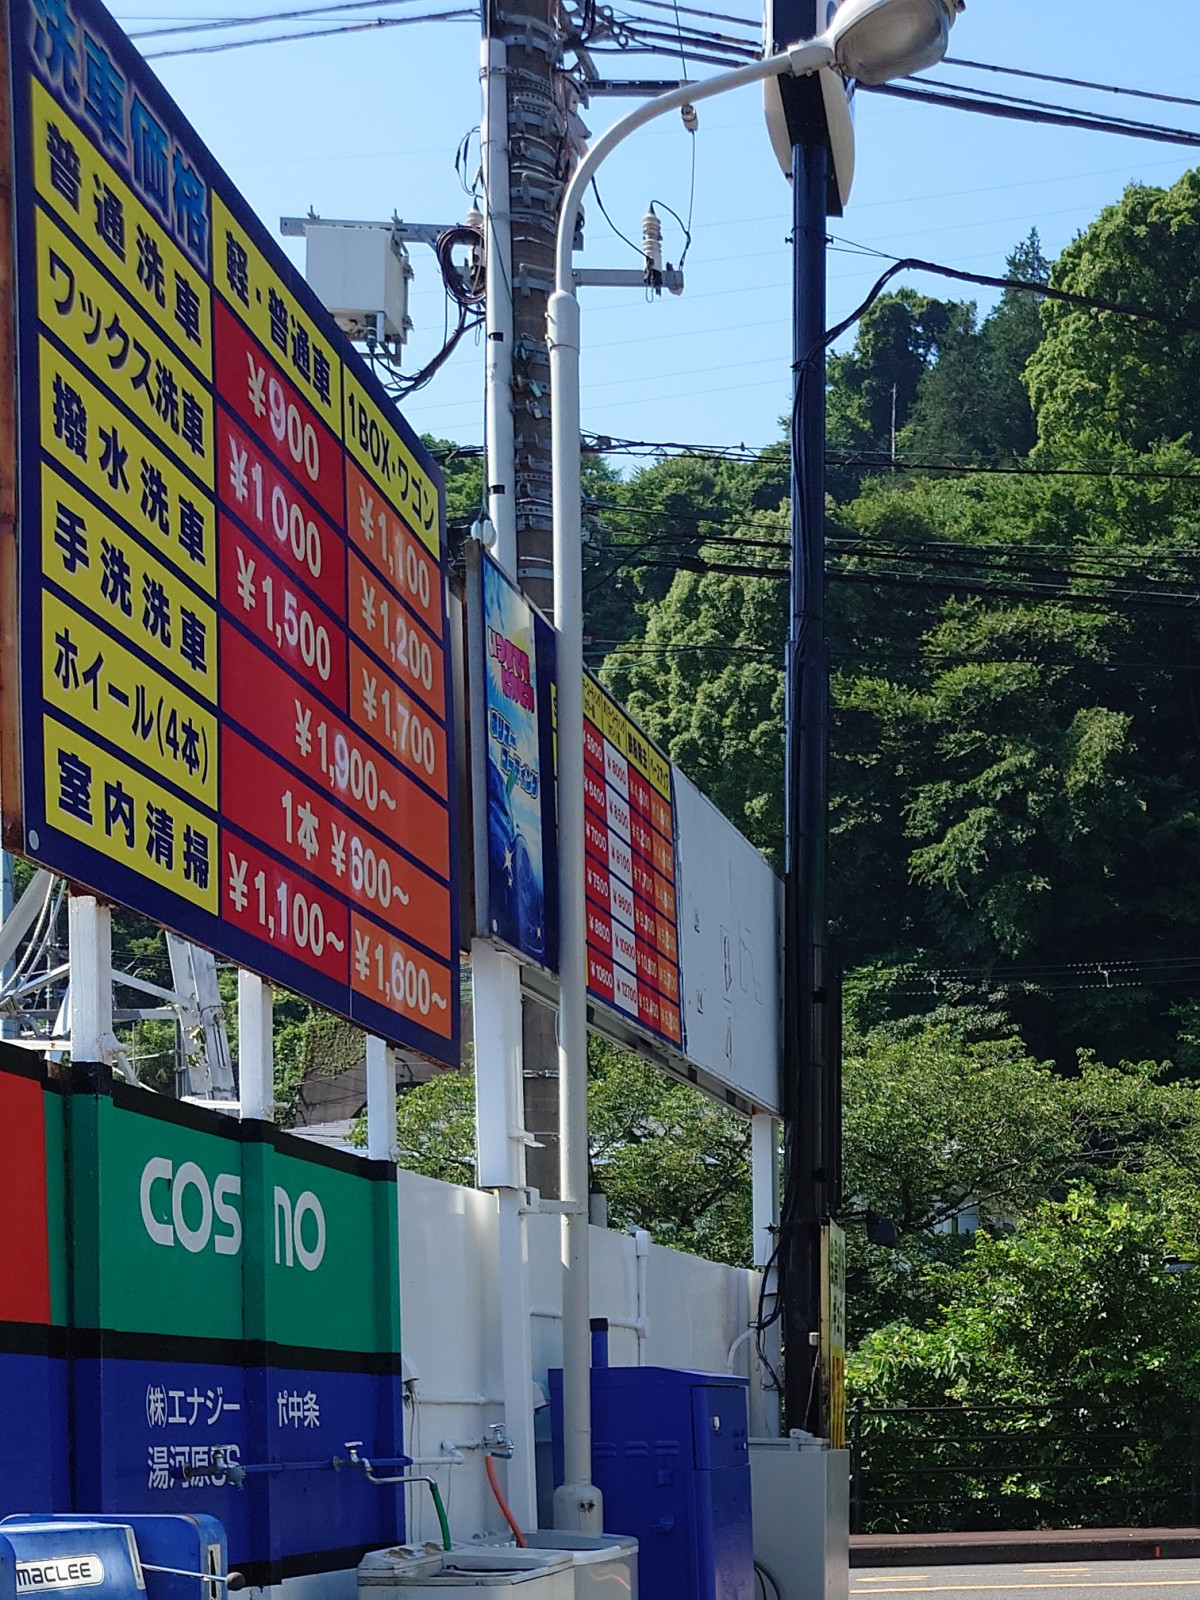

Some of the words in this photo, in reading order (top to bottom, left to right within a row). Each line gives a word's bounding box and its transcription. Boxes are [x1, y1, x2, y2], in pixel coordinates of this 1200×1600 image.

[33, 0, 207, 267] 洗車価格
[46, 120, 201, 348] 普通洗車
[247, 351, 319, 481] ¥900
[49, 247, 206, 459] ワックス洗車
[361, 575, 433, 690] ¥1,200
[53, 371, 206, 567] 撥水洗車
[236, 546, 331, 681] ¥1,500
[362, 667, 435, 775] ¥1,700
[54, 500, 208, 675] 手洗洗車
[57, 748, 209, 890] 室内清掃
[281, 790, 319, 861] 1本
